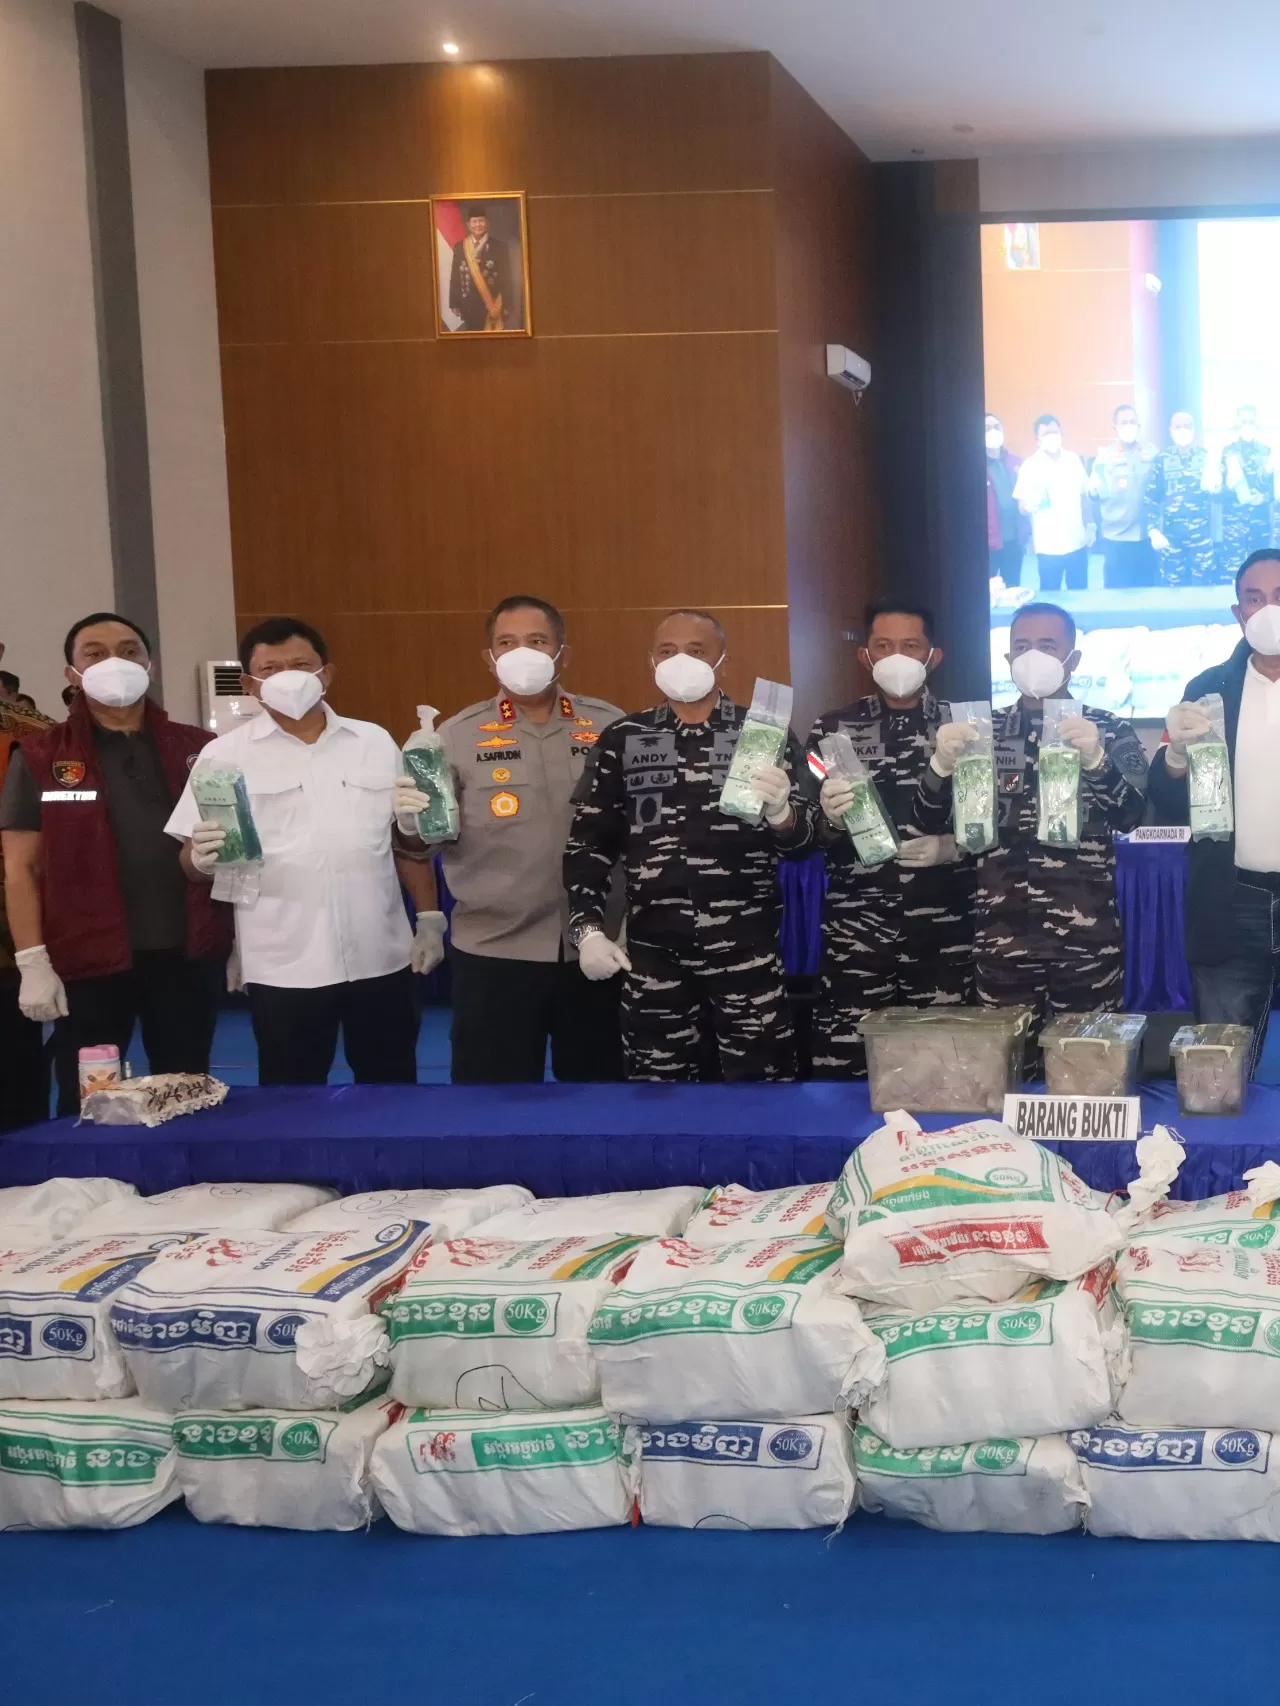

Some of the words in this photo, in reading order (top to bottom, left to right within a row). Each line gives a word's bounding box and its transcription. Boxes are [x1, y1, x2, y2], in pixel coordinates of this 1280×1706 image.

[631, 753, 668, 764] ANDY
[1135, 828, 1178, 840] PANGKOARMADA
[1179, 828, 1185, 840] RI
[1017, 1101, 1078, 1136] BARANG
[1081, 1102, 1128, 1138] BUKTI
[506, 1302, 548, 1324] 50Kg
[749, 1301, 783, 1318] 50Kg
[1003, 1314, 1038, 1331] 50Kg
[48, 1326, 83, 1346] 50Kg
[773, 1436, 807, 1457] 50Kg
[1220, 1436, 1256, 1457] 50Kg
